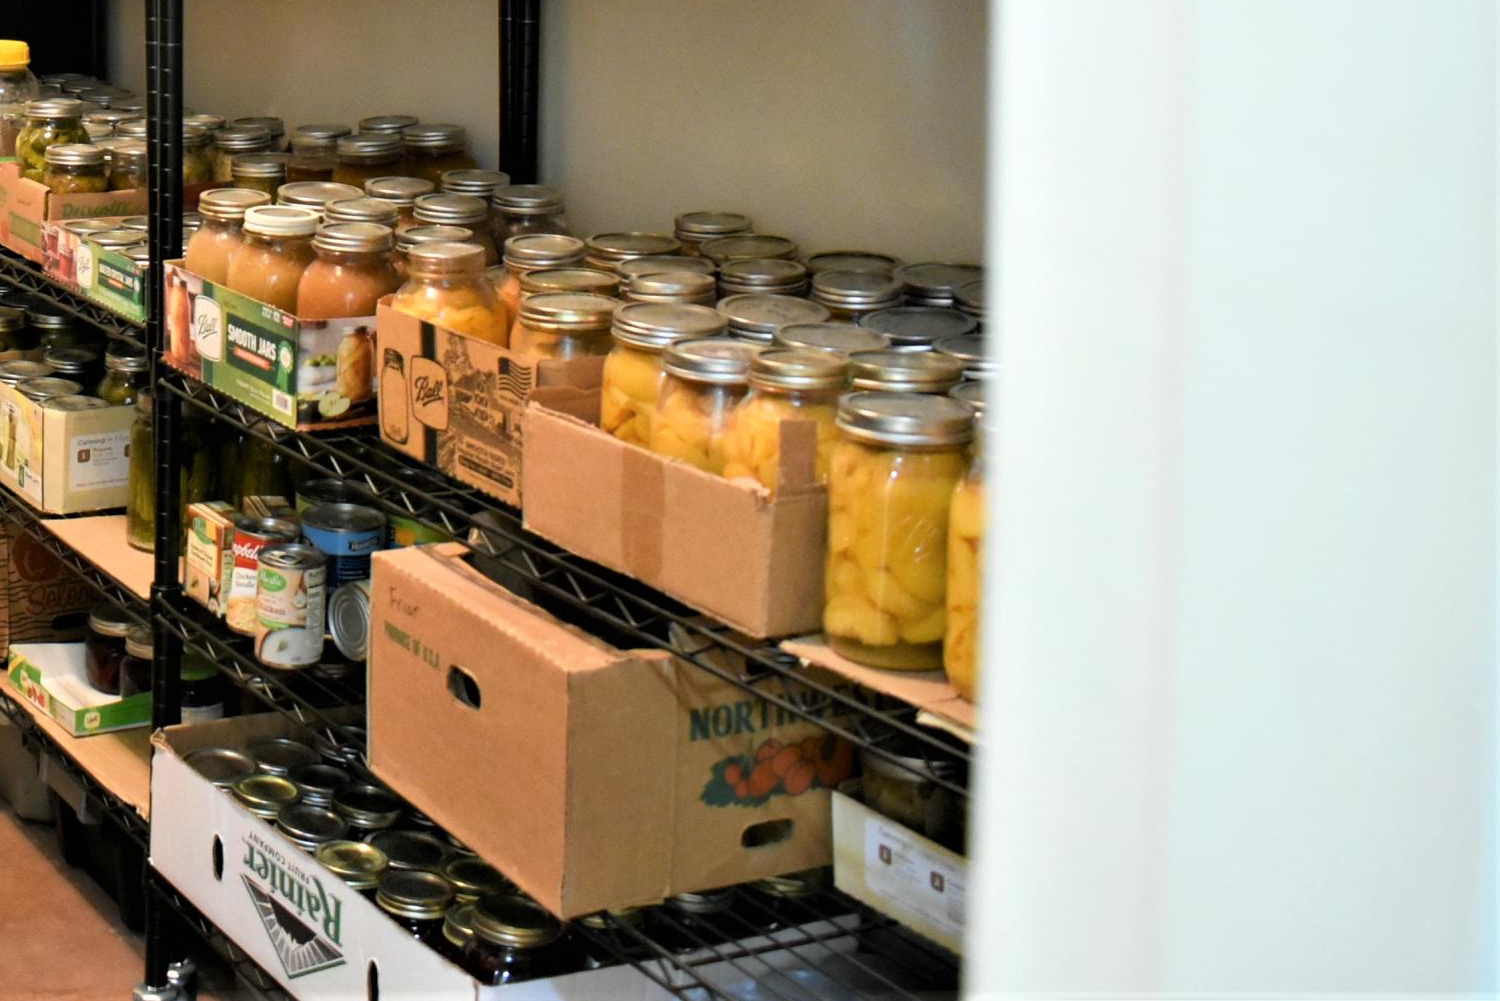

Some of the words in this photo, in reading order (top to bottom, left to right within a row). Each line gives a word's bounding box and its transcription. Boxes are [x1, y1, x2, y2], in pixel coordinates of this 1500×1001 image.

[197, 315, 218, 340] Ball
[228, 323, 257, 353] SMOOTH
[257, 337, 277, 361] JARS
[415, 375, 444, 407] Ball
[248, 831, 287, 867] COMPANY
[287, 863, 310, 885] FRUIT
[243, 841, 343, 947] Rainier
